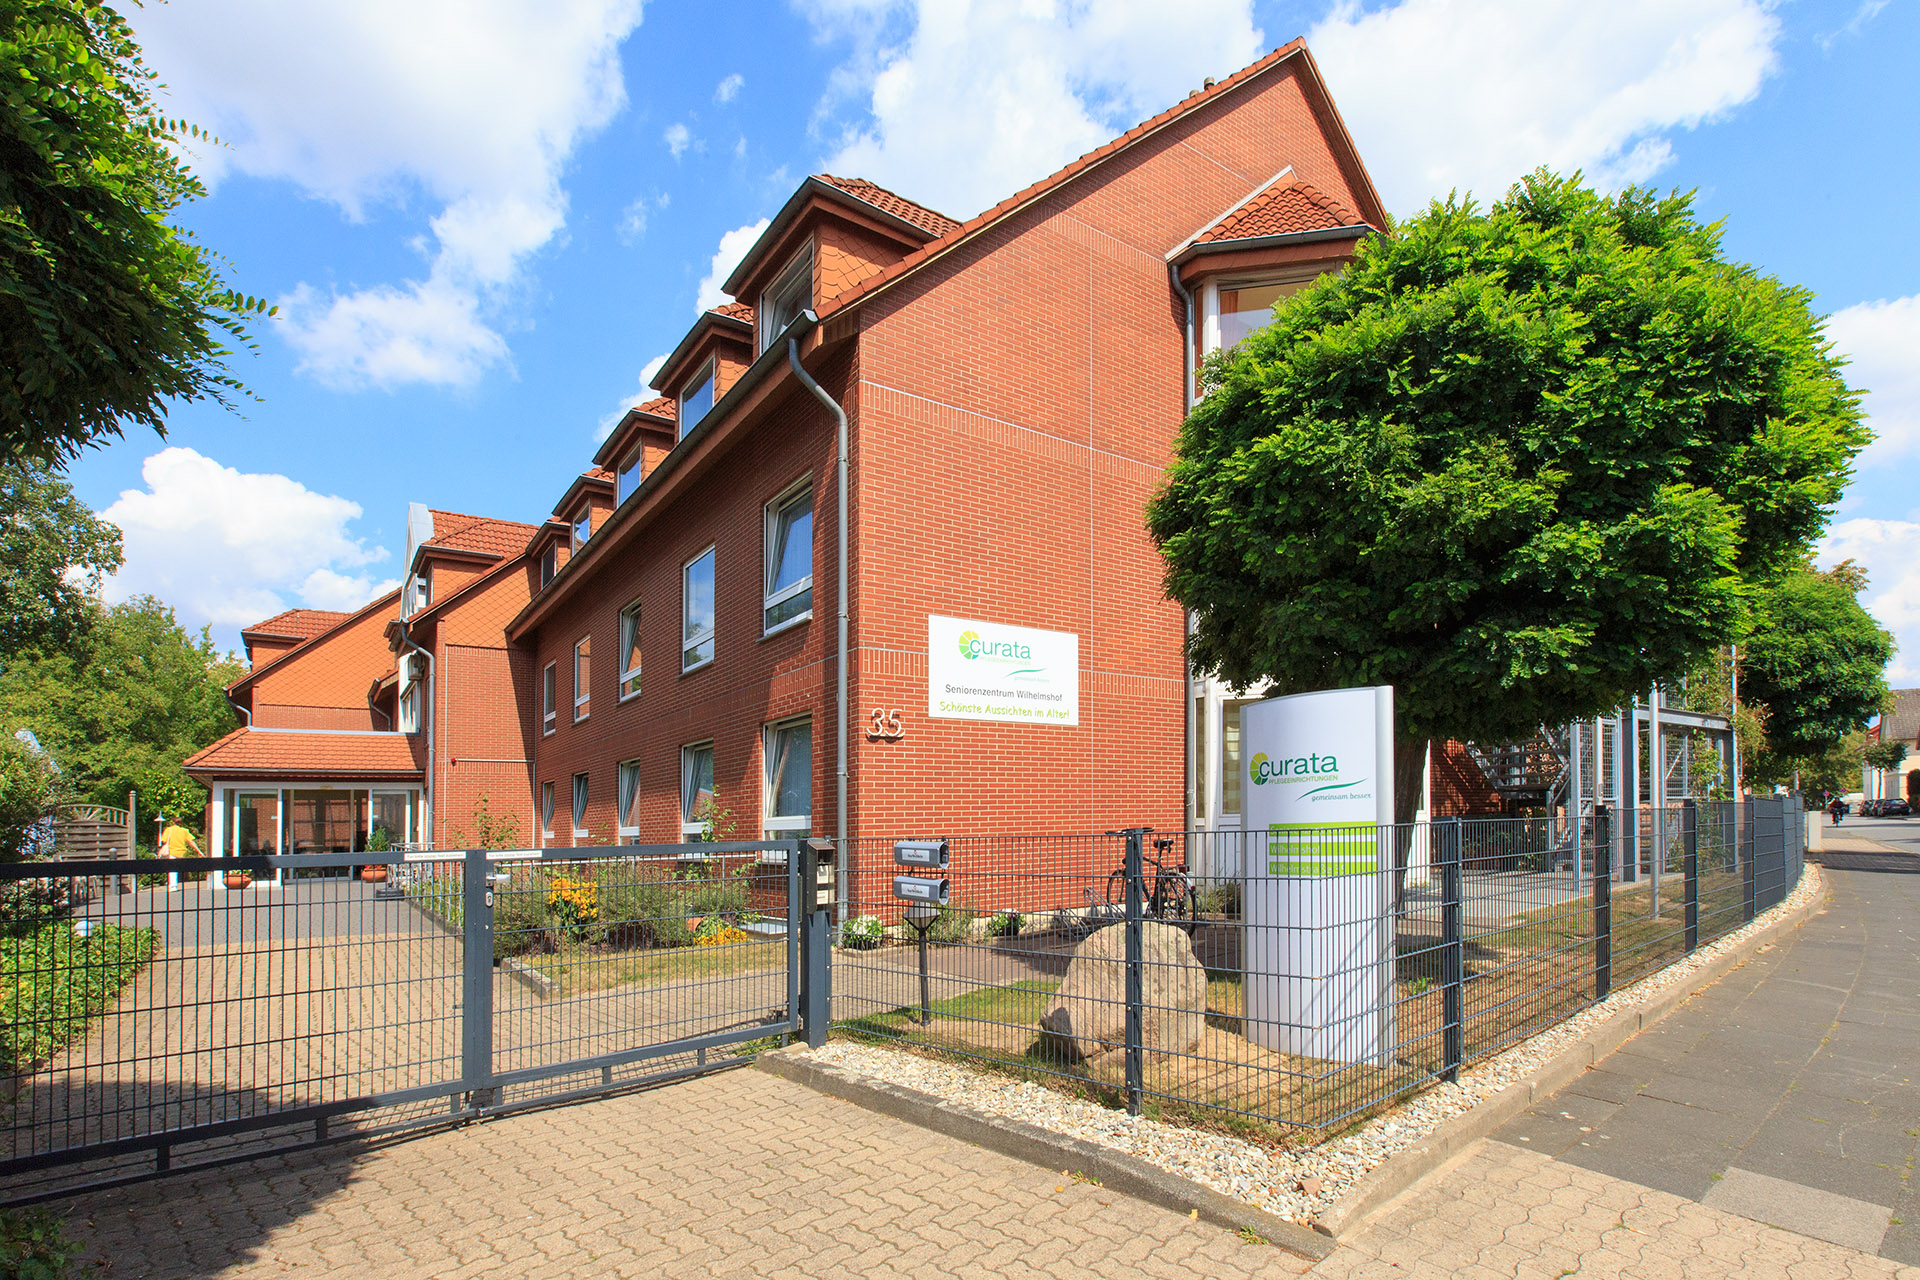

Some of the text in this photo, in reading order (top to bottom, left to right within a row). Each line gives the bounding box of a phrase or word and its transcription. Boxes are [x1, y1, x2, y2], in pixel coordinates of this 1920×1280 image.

[970, 639, 1032, 660] curata
[945, 684, 1063, 702] Seniorenzentrum Wilhelmshof
[939, 701, 1070, 719] Schönste Aussichten im Alter!
[866, 707, 903, 738] 35
[1259, 753, 1339, 778] curata
[1311, 793, 1348, 802] gemeinsam
